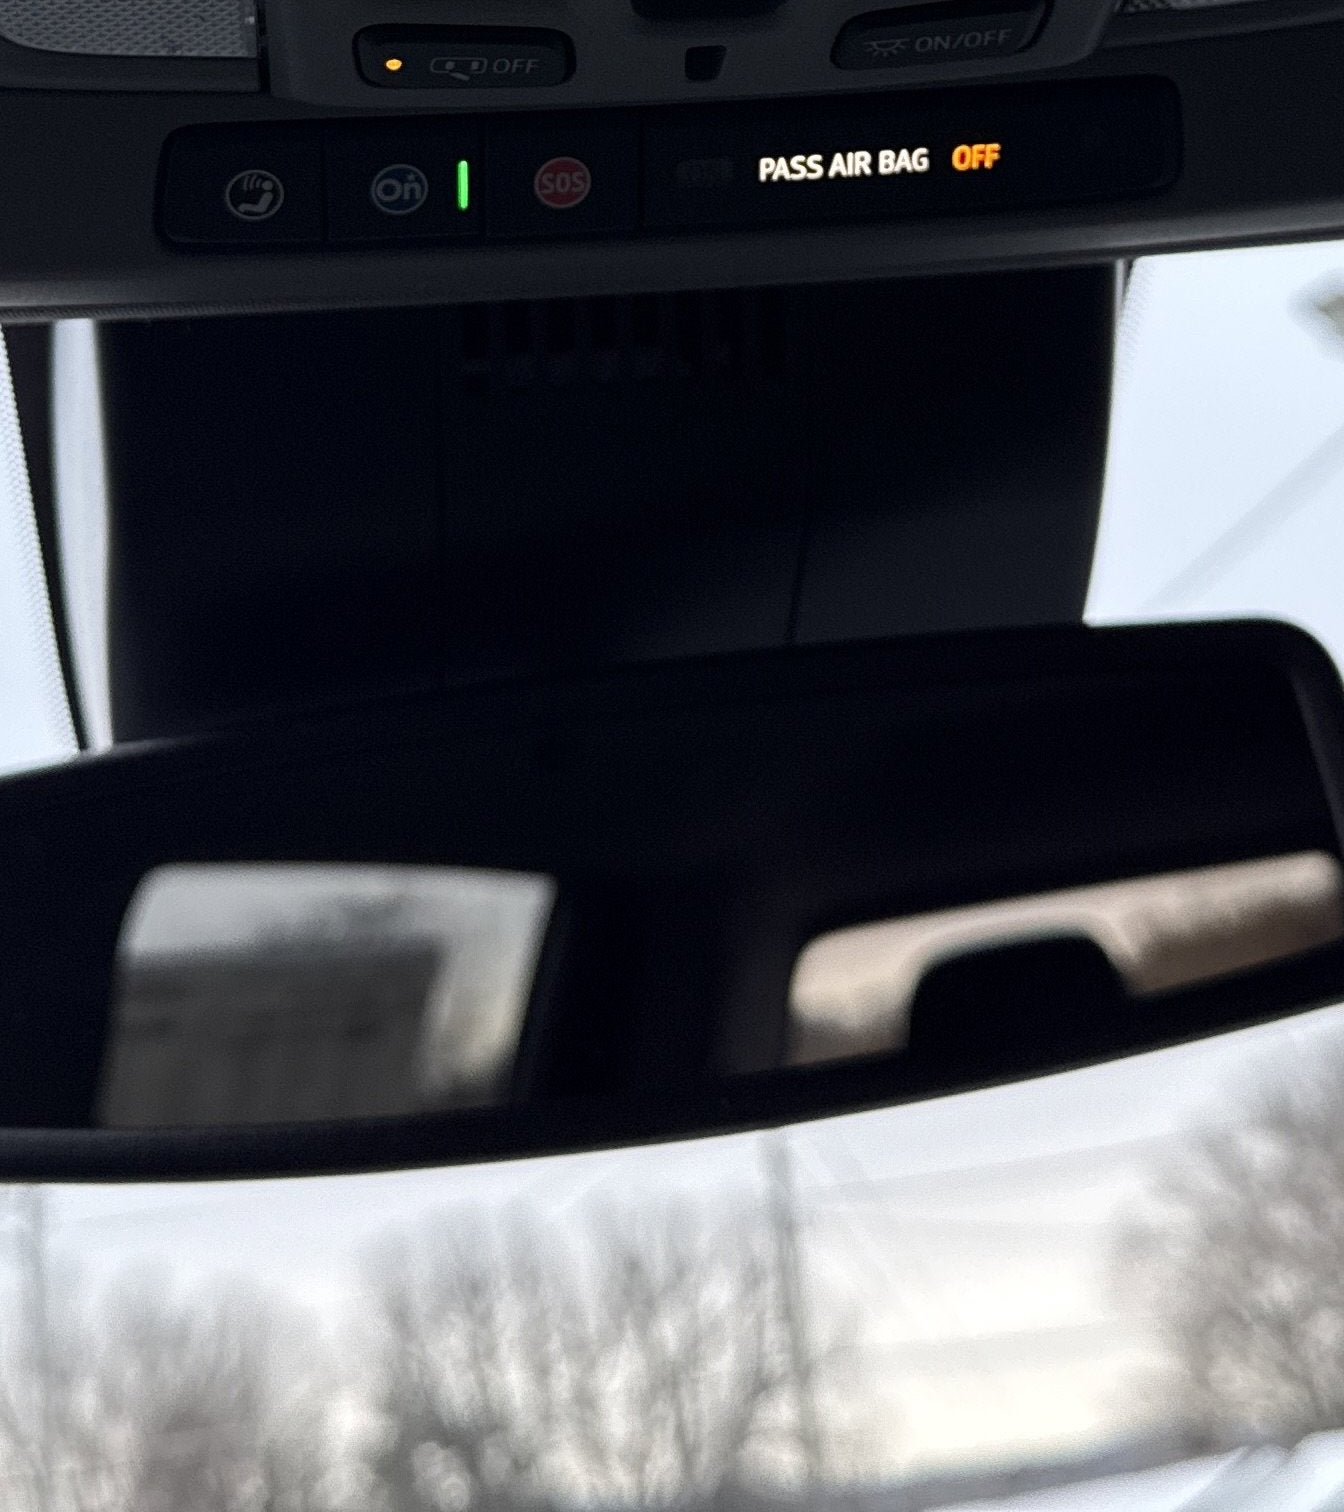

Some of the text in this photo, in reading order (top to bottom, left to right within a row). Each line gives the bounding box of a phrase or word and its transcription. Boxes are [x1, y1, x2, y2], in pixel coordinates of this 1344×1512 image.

[913, 27, 1013, 54] ON/OFF
[491, 56, 540, 76] OFF
[757, 141, 1002, 183] PASS AIR BAG OFF
[540, 170, 585, 195] SOS
